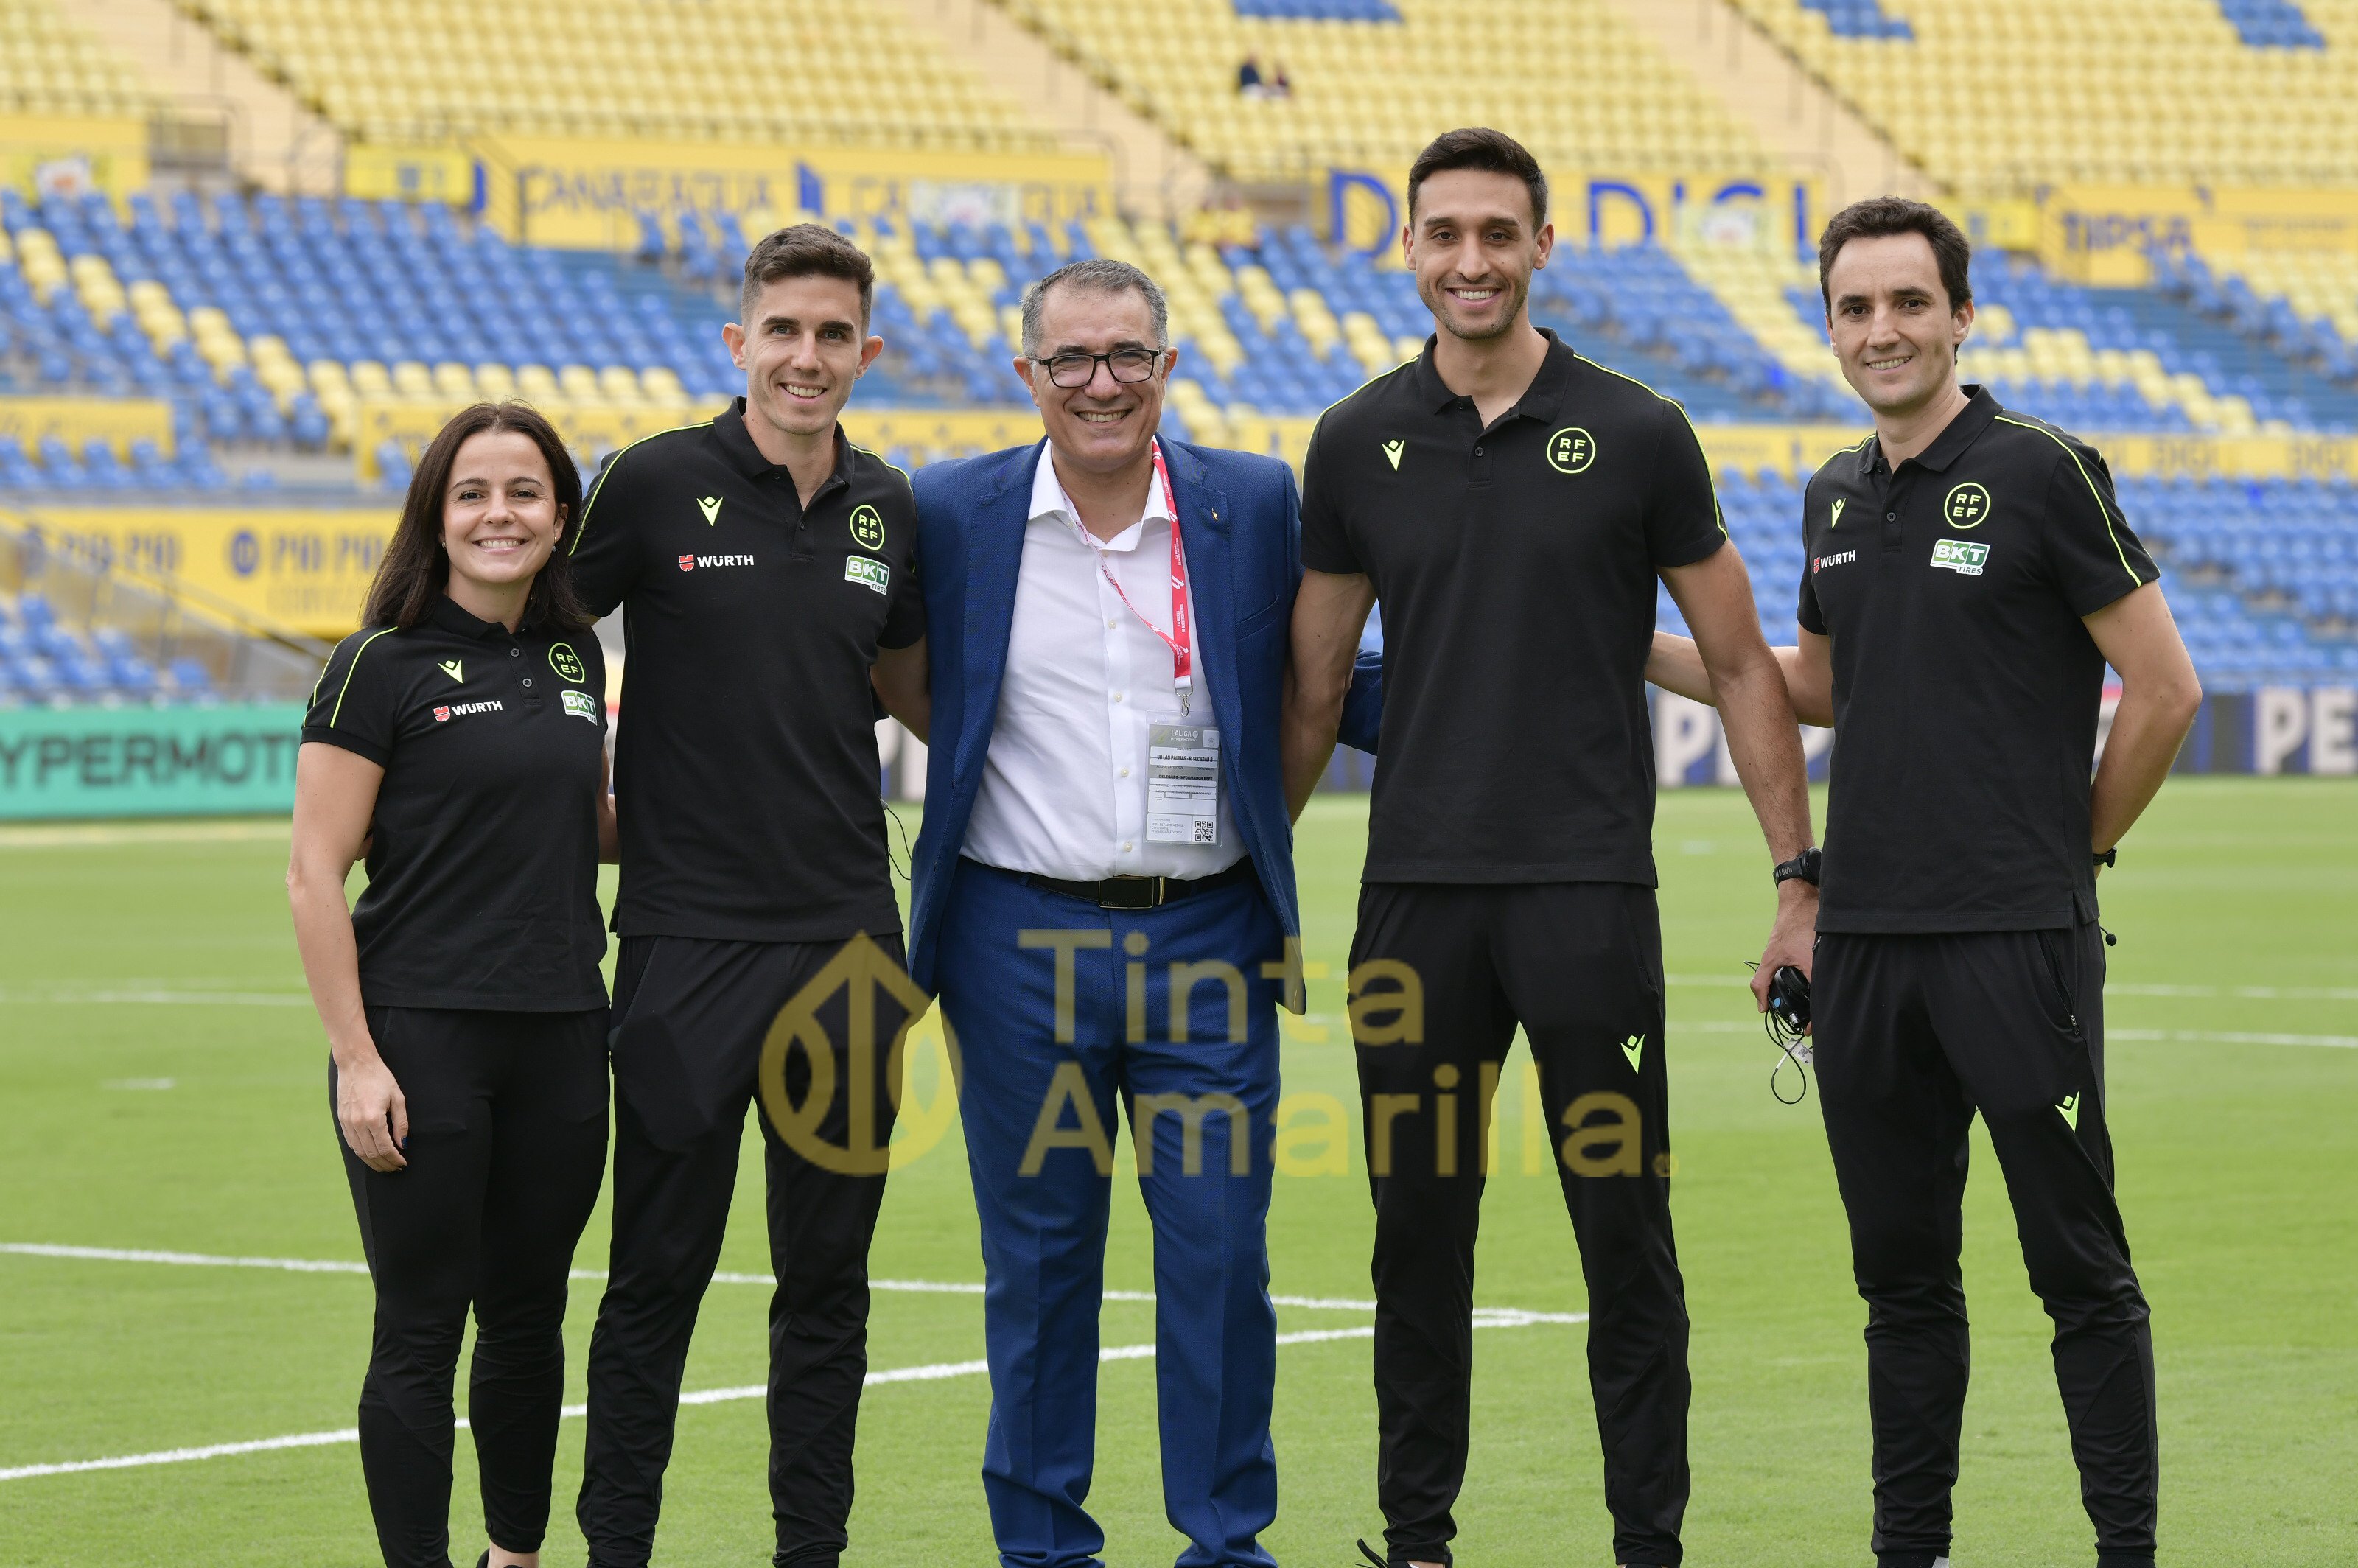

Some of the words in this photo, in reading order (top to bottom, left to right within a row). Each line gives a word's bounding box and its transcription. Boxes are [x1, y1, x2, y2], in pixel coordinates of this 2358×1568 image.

[1559, 438, 1586, 449] RF
[1558, 451, 1584, 463] EF
[1956, 493, 1982, 505] RF
[1953, 506, 1979, 518] EF
[858, 514, 877, 528] RF
[858, 528, 878, 540] EF
[1934, 544, 1986, 562] BKT
[697, 554, 755, 568] WÜRTH
[1820, 550, 1856, 569] WÜRTH
[848, 560, 888, 582] BKT
[1958, 566, 1982, 575] TIRES
[871, 582, 886, 594] TIRES
[556, 653, 574, 663] RF
[560, 664, 579, 674] EF
[451, 701, 503, 716] WÜRTH
[564, 695, 595, 713] BKT
